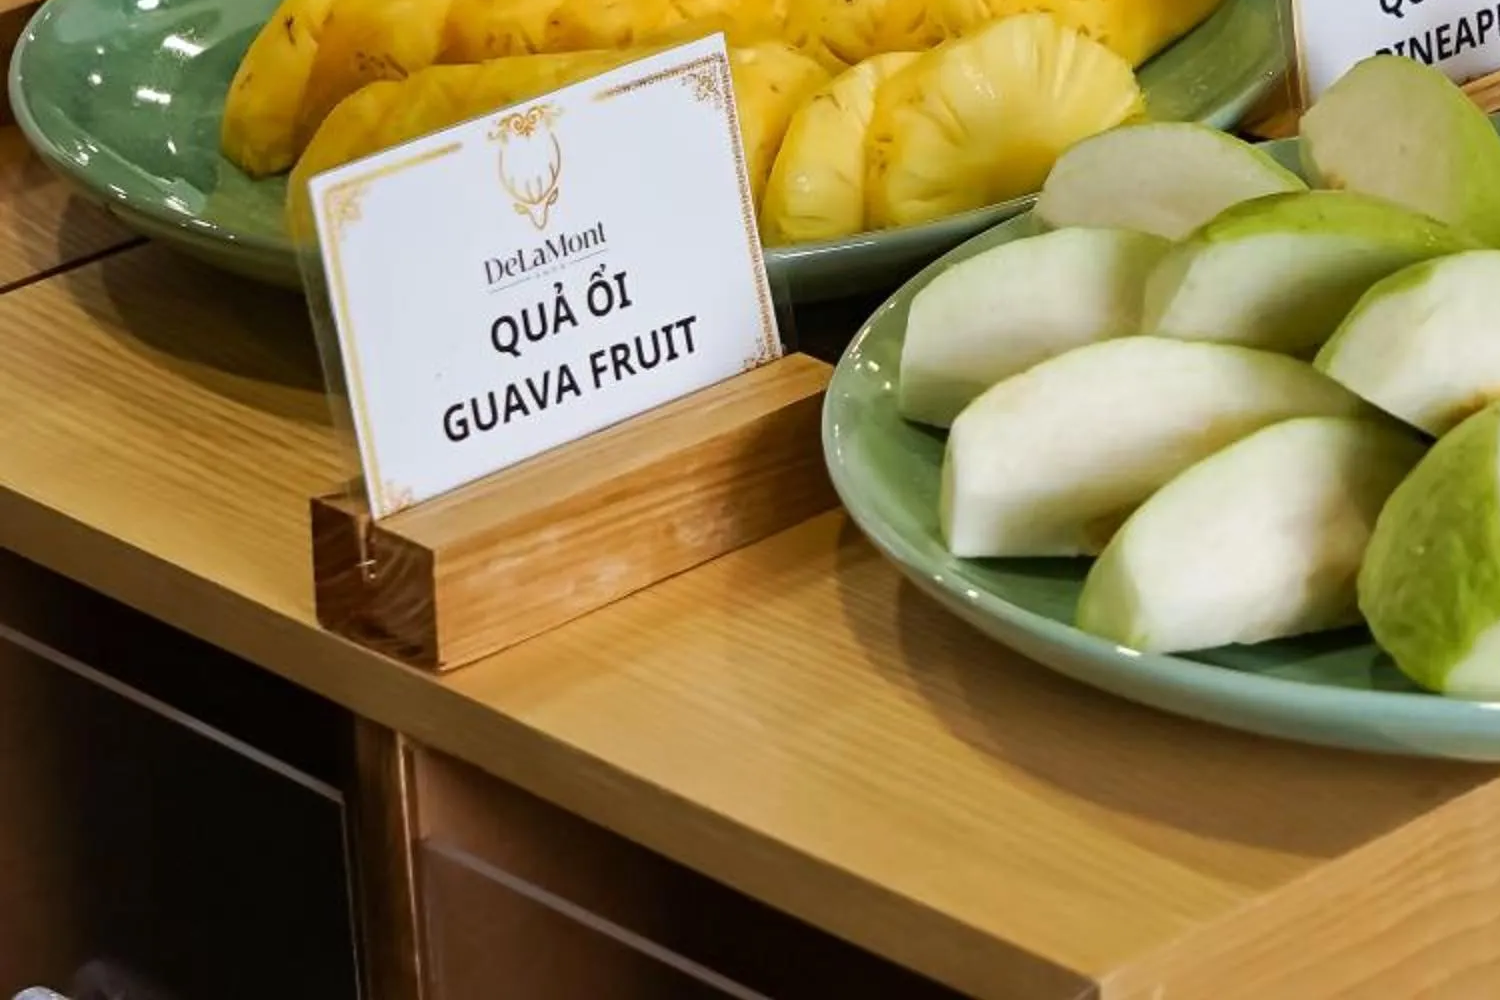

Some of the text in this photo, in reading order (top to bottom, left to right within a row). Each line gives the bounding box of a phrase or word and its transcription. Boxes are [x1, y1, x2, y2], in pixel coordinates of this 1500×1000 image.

[484, 221, 606, 285] DeLaMont
[490, 263, 632, 357] QUẢ ỔI
[443, 315, 697, 443] GUAVA FRUIT
